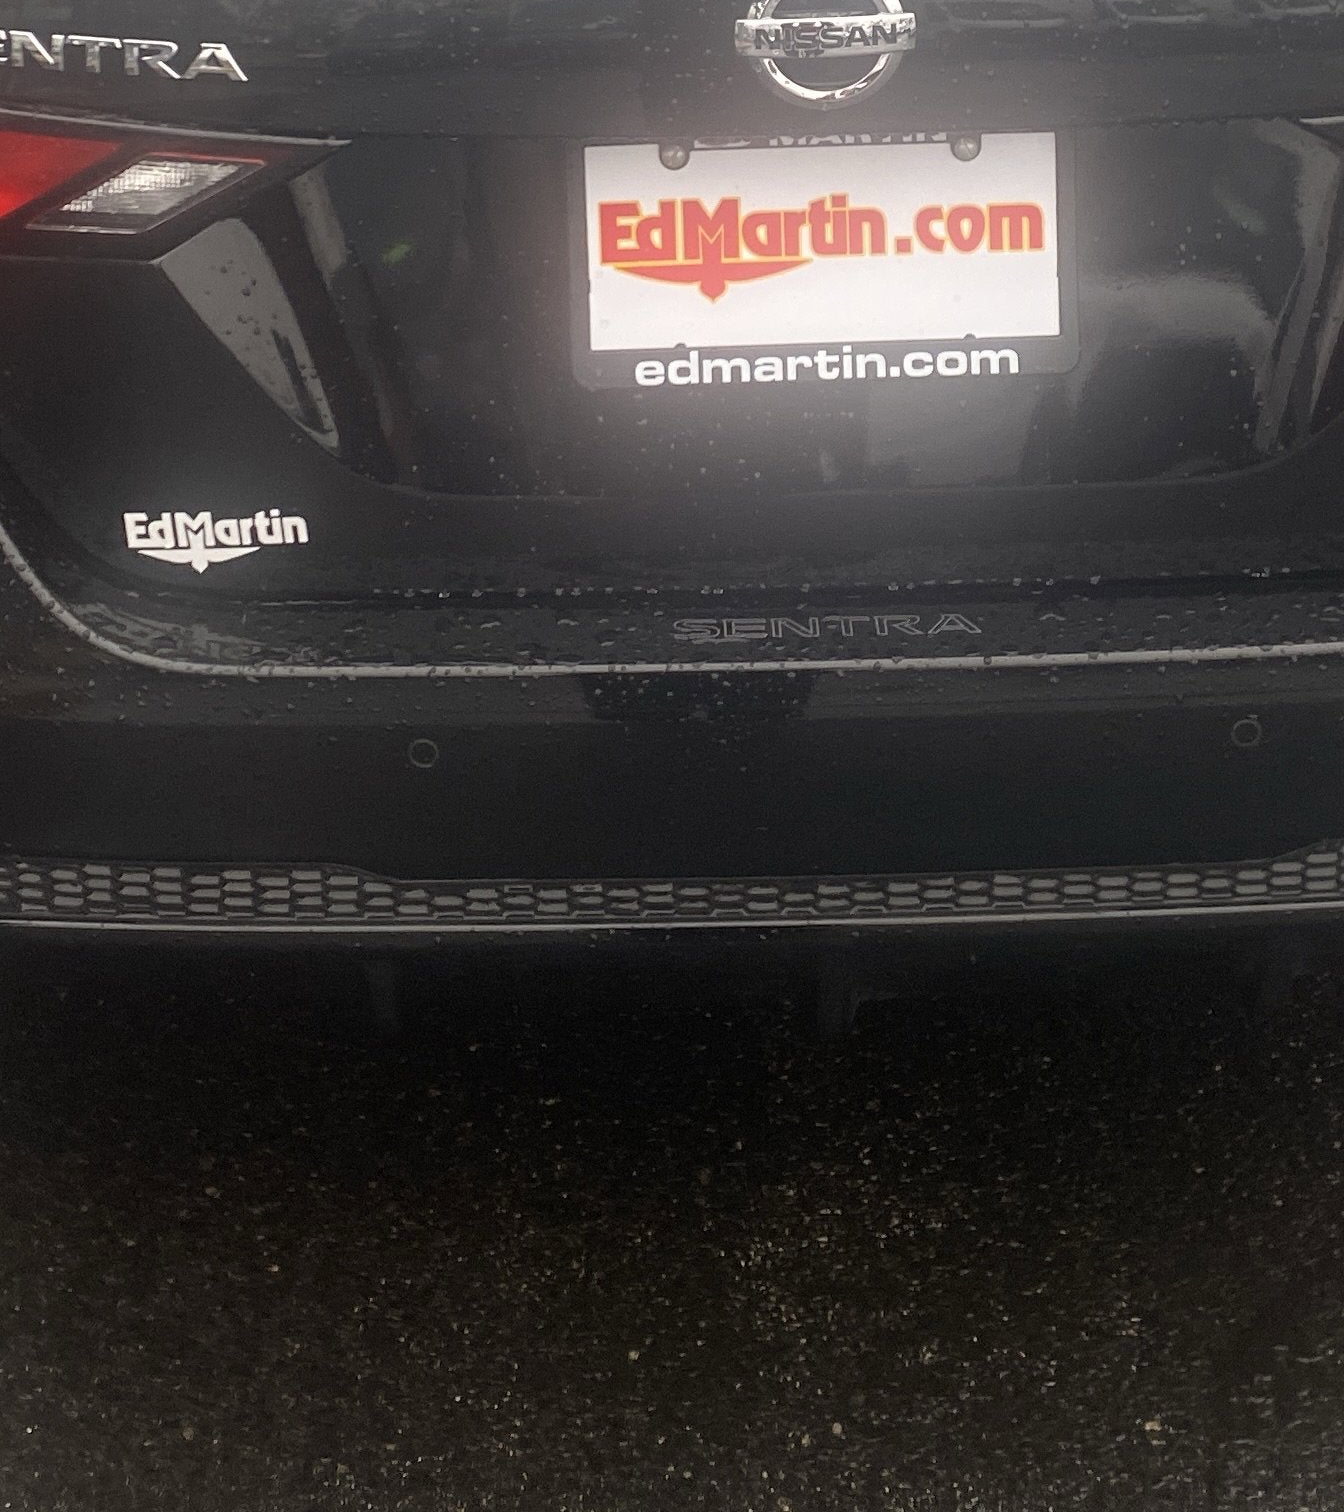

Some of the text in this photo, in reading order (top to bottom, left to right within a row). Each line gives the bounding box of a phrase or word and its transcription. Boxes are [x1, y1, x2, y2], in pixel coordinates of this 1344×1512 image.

[754, 23, 899, 50] NISSAN
[597, 193, 1045, 268] EdMartin.com
[634, 345, 1020, 387] edmartin.com
[672, 613, 984, 641] SENTRA
